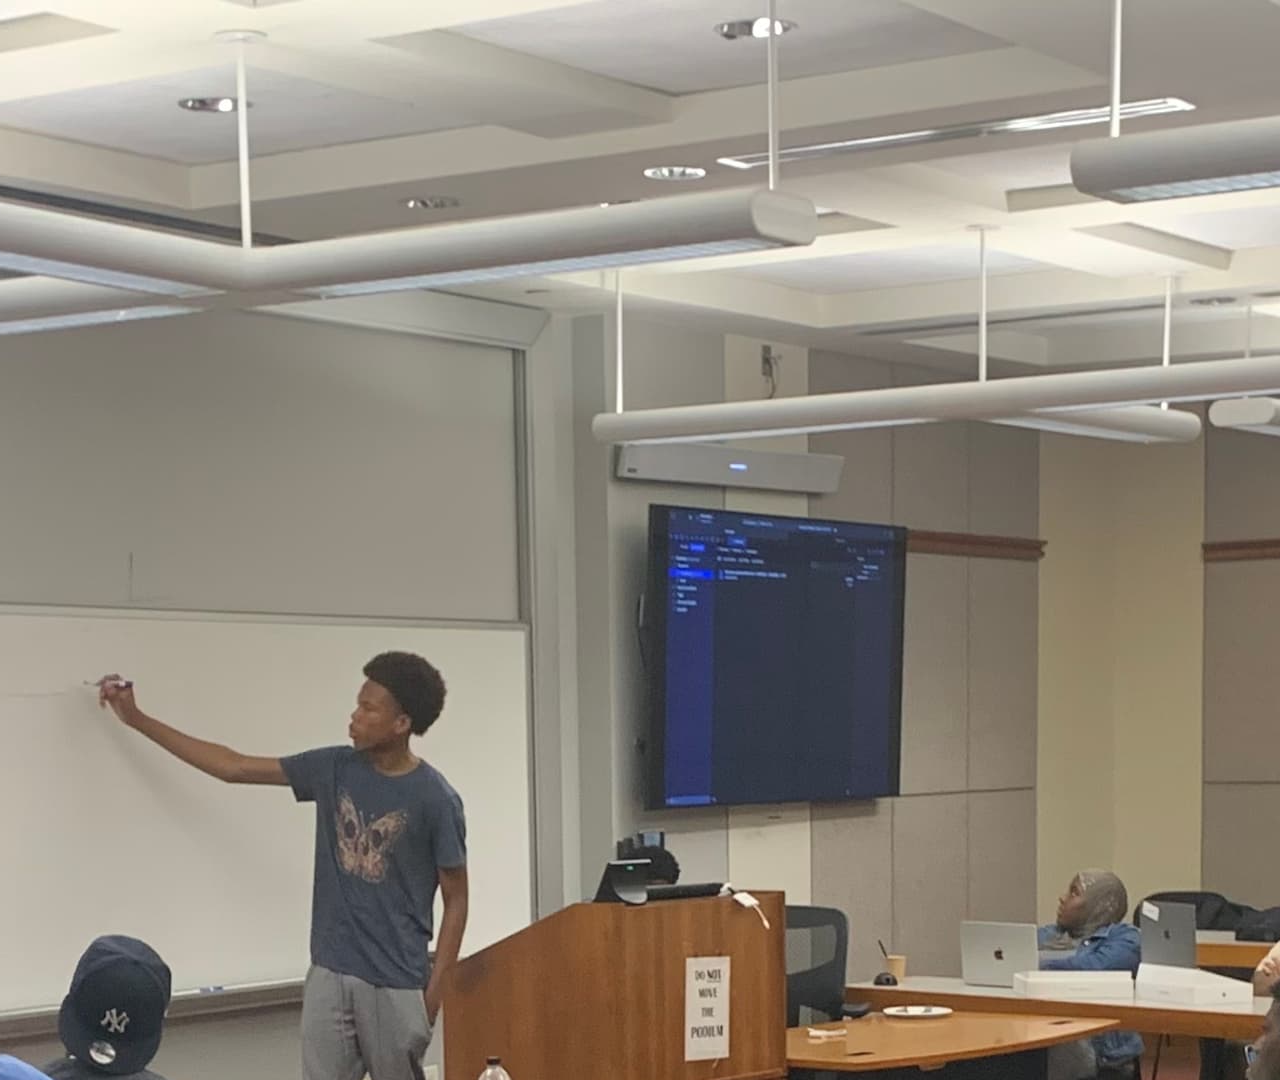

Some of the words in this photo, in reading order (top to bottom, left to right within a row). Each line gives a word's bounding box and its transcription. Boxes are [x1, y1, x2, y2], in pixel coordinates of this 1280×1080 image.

[707, 969, 721, 980] NOT
[698, 988, 718, 998] MOVE
[701, 1007, 714, 1017] THE
[691, 1025, 723, 1038] PODIUM
